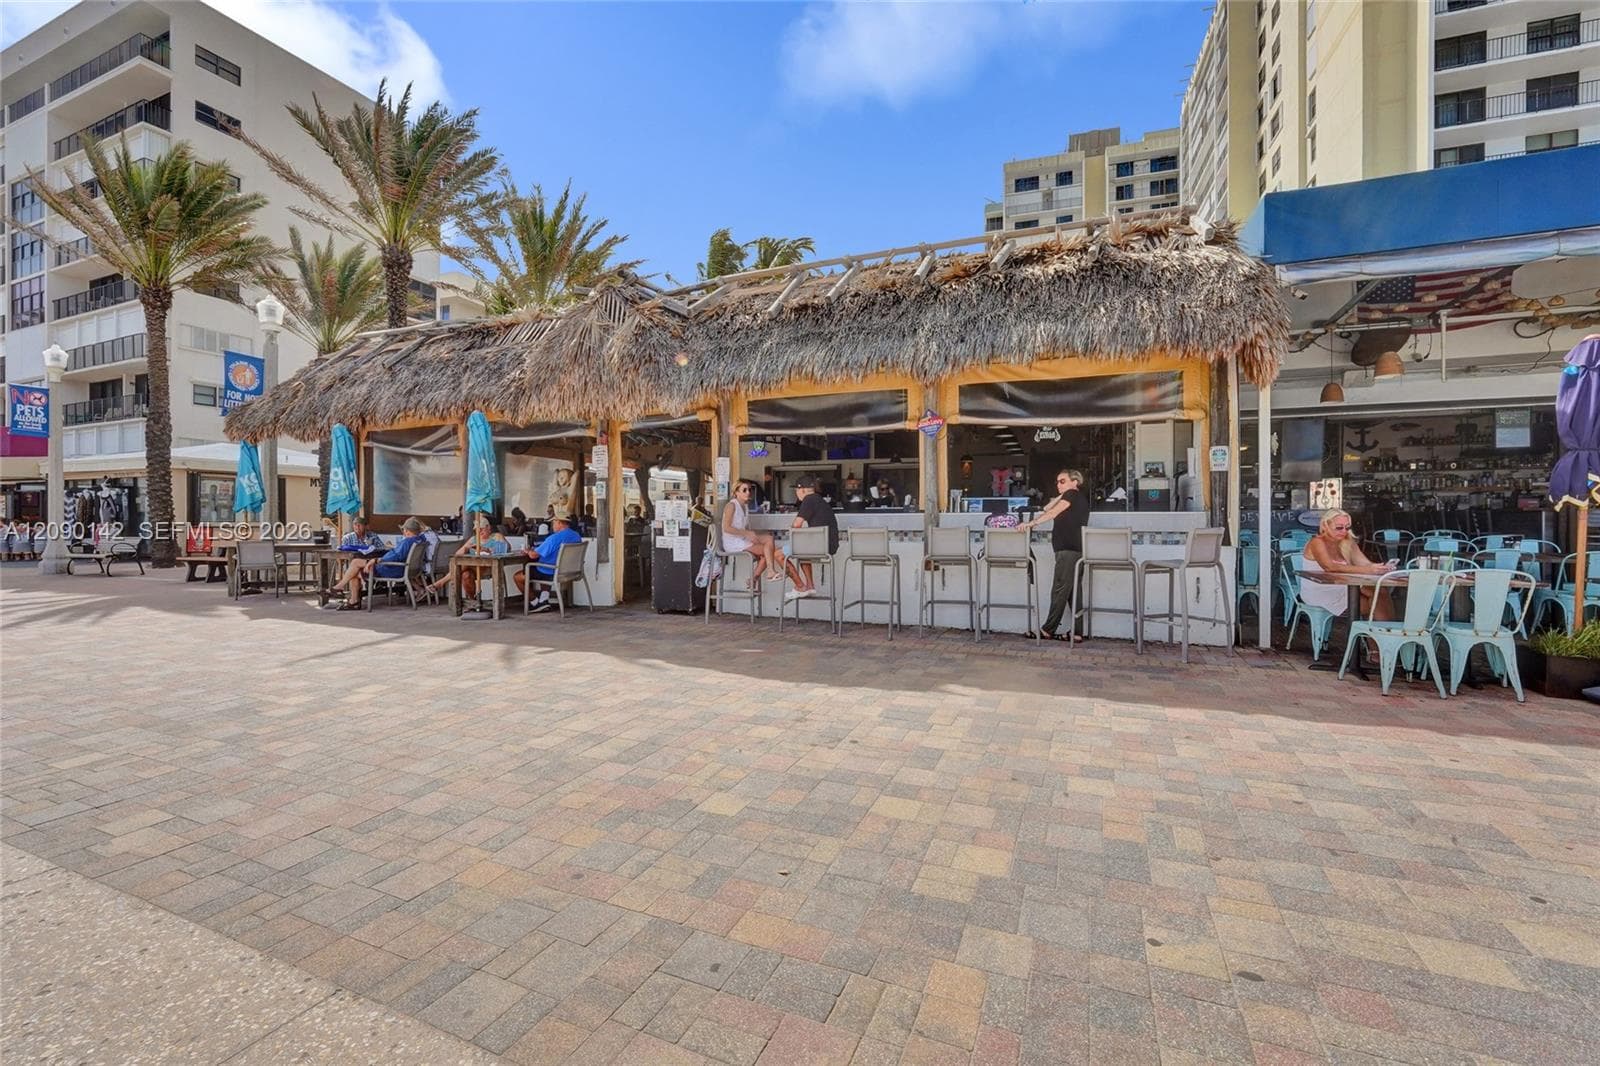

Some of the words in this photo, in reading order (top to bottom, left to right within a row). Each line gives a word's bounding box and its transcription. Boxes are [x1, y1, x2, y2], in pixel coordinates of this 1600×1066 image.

[226, 390, 242, 401] FOR
[16, 404, 45, 418] PETS
[14, 414, 47, 424] ALLOWED
